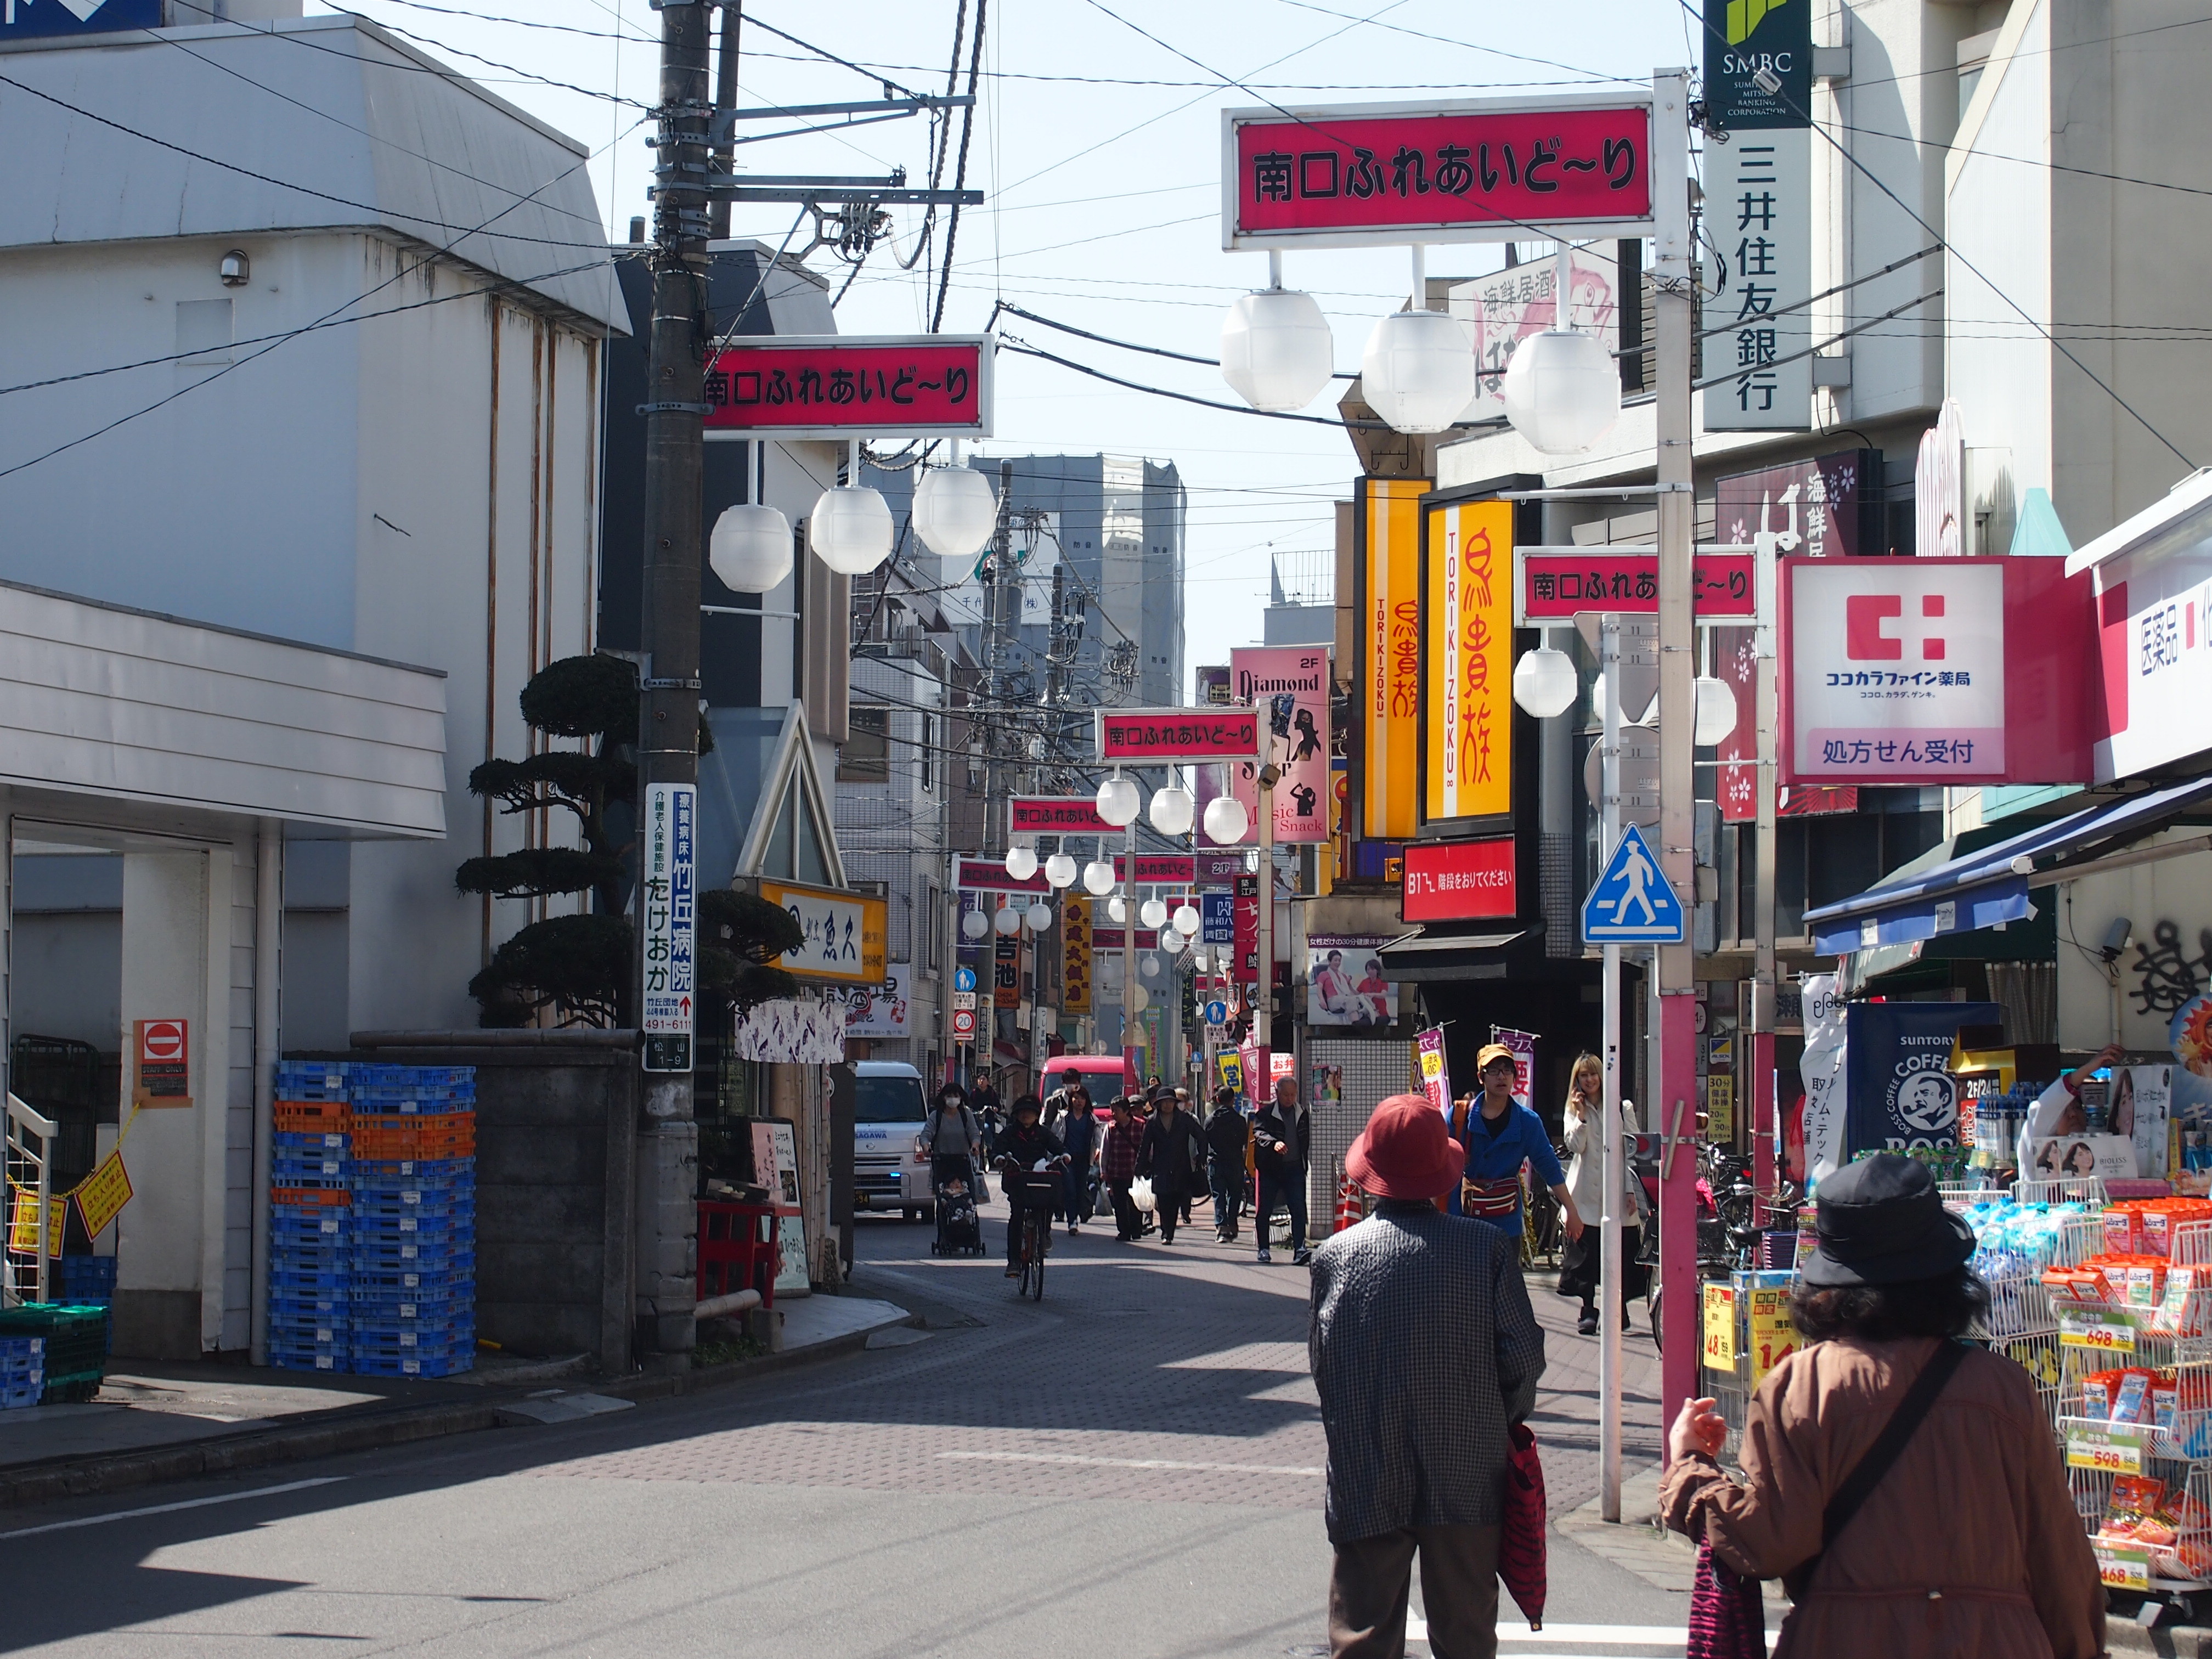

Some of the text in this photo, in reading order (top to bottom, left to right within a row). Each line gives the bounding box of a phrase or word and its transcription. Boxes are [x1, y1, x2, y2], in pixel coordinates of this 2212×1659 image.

[1723, 53, 1791, 74] SMBC
[1735, 146, 1777, 411] 三井住友銀行
[1483, 268, 1557, 313] 海鮮居酒
[2142, 604, 2177, 676] 医薬品
[1377, 599, 1385, 712] TORIKIZOKU
[1446, 532, 1456, 774] TORIKIZOKU
[1300, 658, 1318, 668] 2F
[1827, 672, 1970, 686] ココカラファイン薬局
[1240, 670, 1318, 707] Diamond
[1823, 740, 1974, 764] 処方せん受付
[1246, 804, 1294, 825] Msic
[1280, 819, 1323, 832] Snack
[1212, 862, 1229, 874] 2F
[1408, 869, 1511, 894] B1 階段をおりてください
[672, 858, 692, 991] 竹丘病院
[647, 876, 669, 992] たけおか
[647, 998, 679, 1007] 竹丘団地
[646, 1020, 691, 1029] 491-6111
[958, 1017, 970, 1027] 20
[654, 1043, 685, 1052] 松山
[1900, 1036, 1955, 1046] SUNTORY
[659, 1056, 681, 1065] 1-9
[1709, 1077, 1731, 1087] 30分
[2086, 1330, 2130, 1347] 698 753
[2094, 1451, 2119, 1468] 598
[2101, 1567, 2126, 1584] 468
